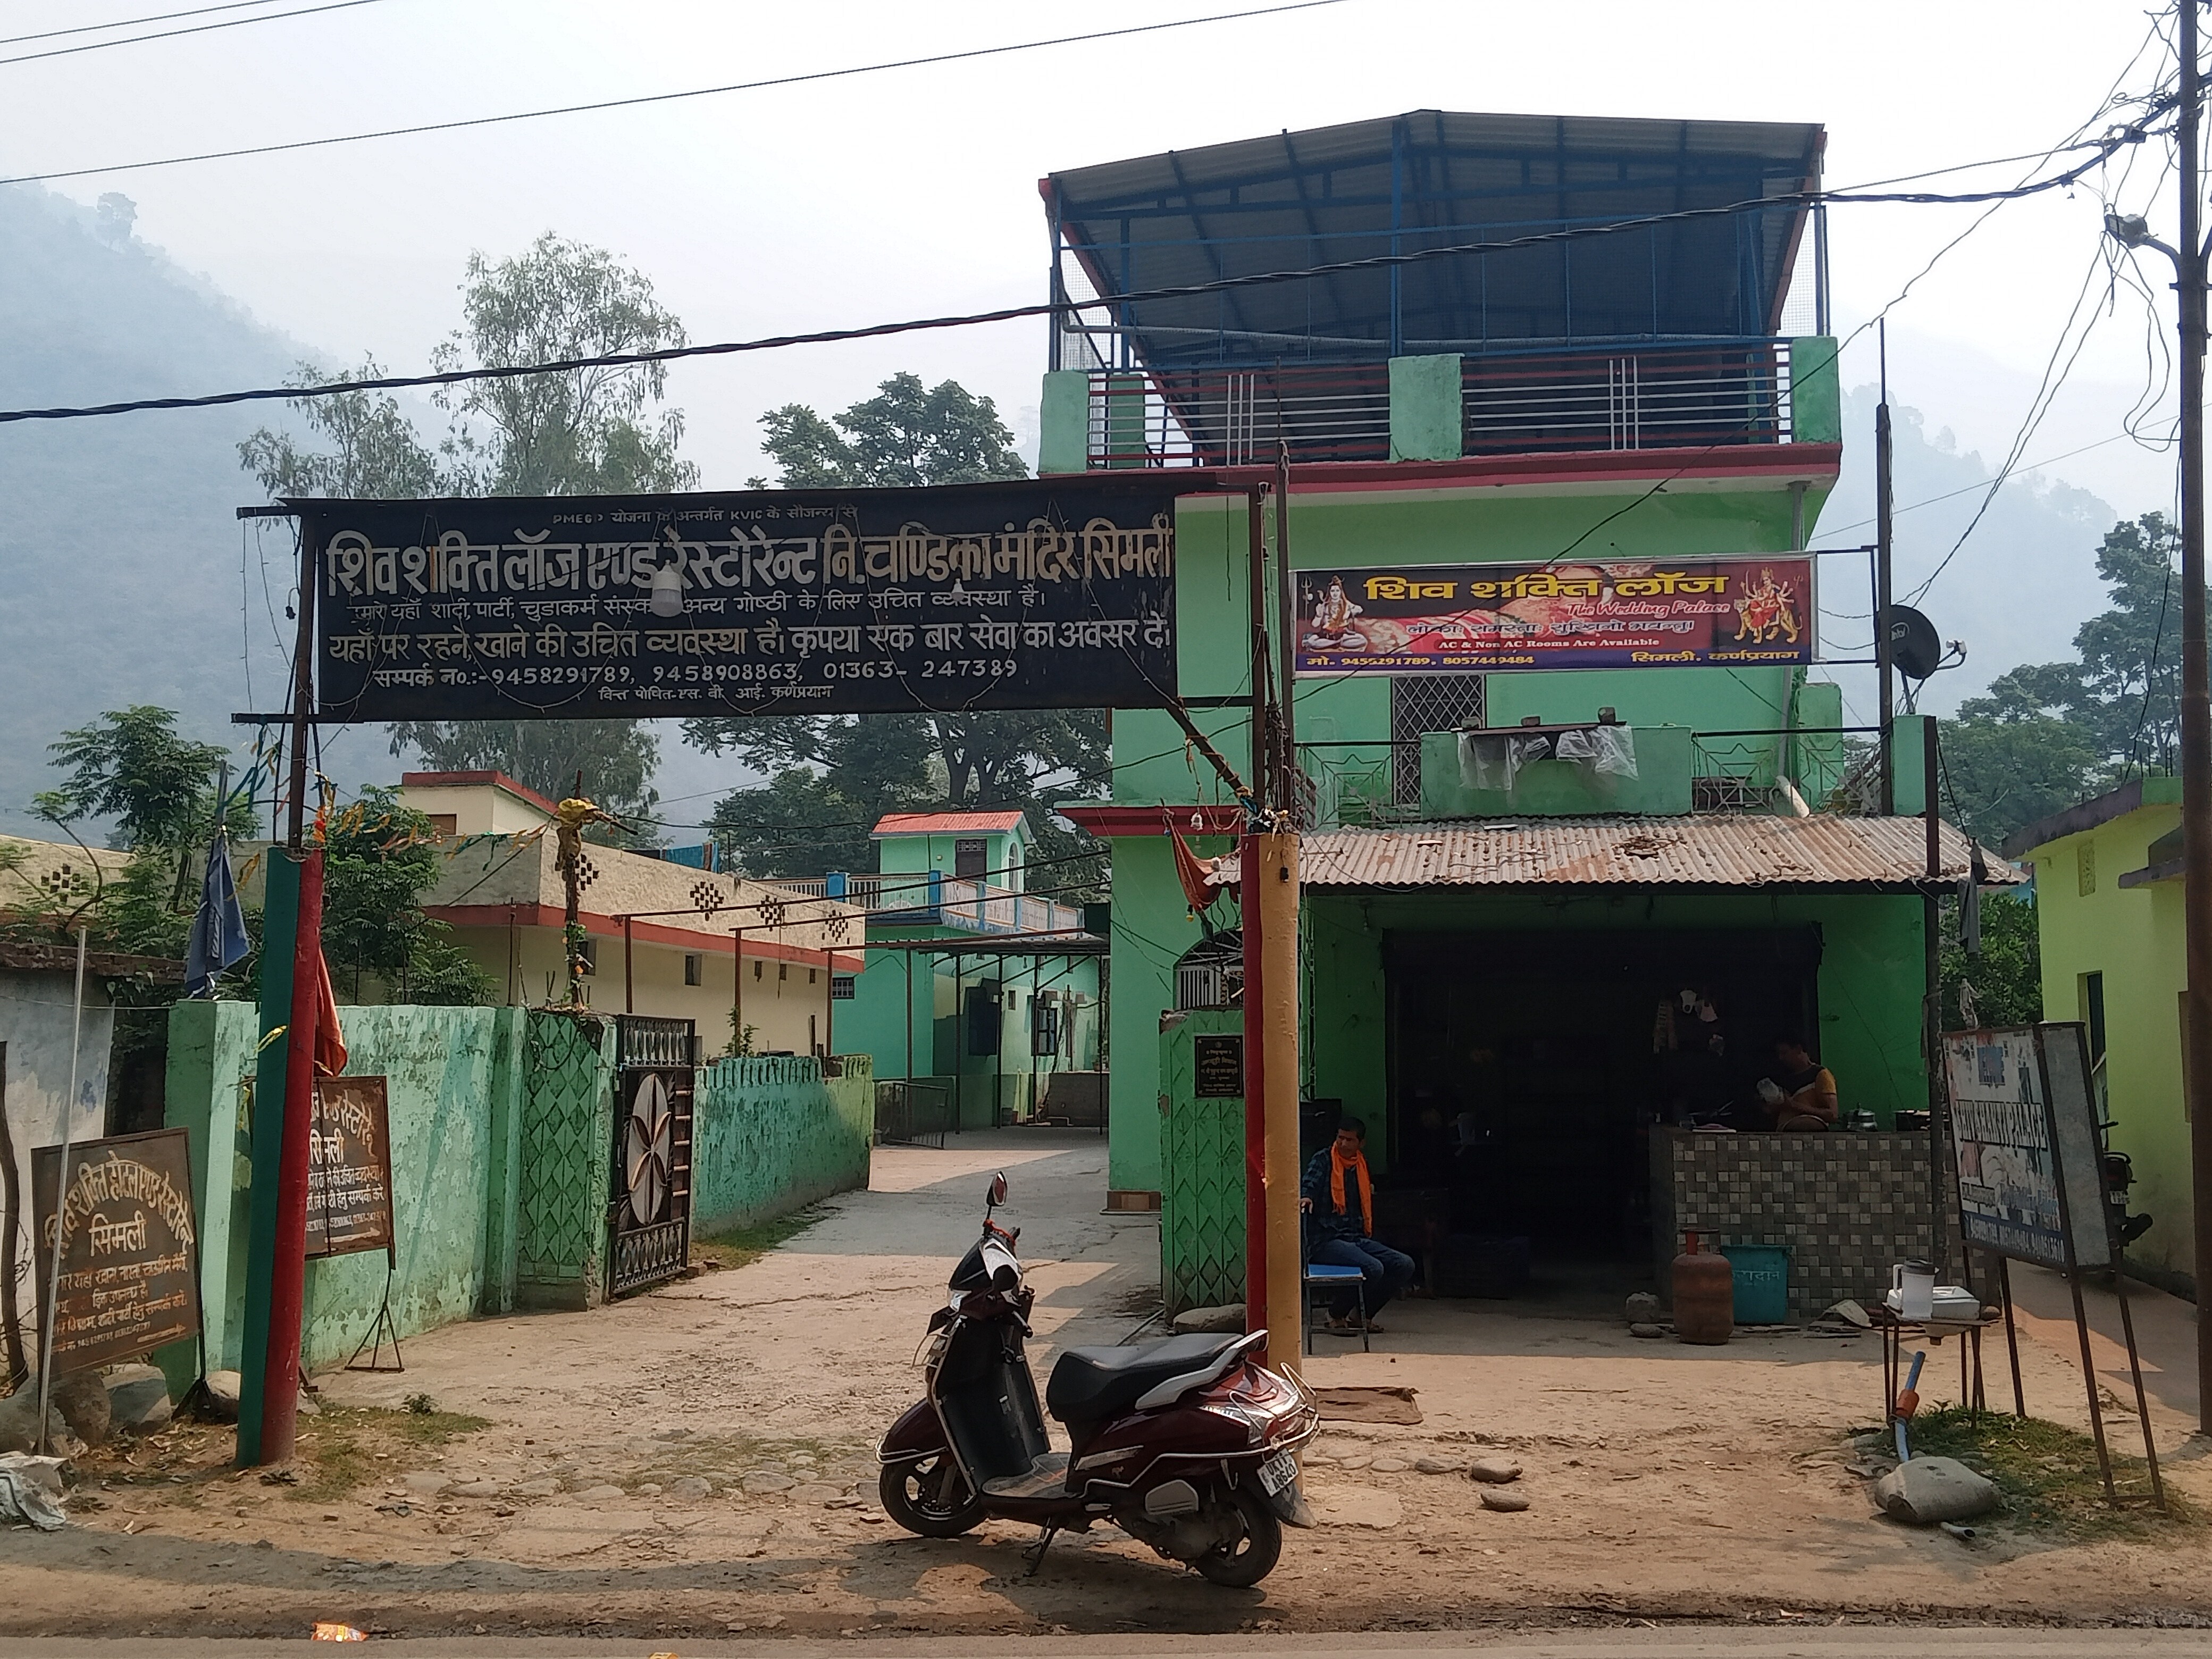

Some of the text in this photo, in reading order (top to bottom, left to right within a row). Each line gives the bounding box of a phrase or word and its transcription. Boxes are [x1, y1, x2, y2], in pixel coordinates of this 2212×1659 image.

[610, 509, 652, 522] योजना
[676, 506, 724, 523] अन्तर्गत
[731, 510, 763, 520] KVIC
[766, 505, 781, 518] के
[325, 530, 399, 596] शिव
[401, 530, 499, 594] शक्ति
[502, 528, 582, 592] लॉज
[585, 542, 660, 590] एण्ड
[820, 524, 865, 584] नि.
[857, 521, 992, 583] चण्डिका
[994, 517, 1079, 583] मंदिर
[1078, 513, 1173, 580] सिमली
[1363, 572, 1730, 600] शिव शक्ति लॉज
[473, 597, 515, 619] पार्टी,
[682, 597, 727, 615] अन्य
[736, 591, 792, 613] गोष्ठी
[798, 589, 819, 611] के
[825, 591, 862, 610] लिए
[868, 586, 925, 609] उचित
[931, 589, 1011, 607] व्यवस्था
[1568, 600, 1730, 618] The Wedding Palace
[330, 627, 375, 663] यहाँ
[381, 634, 410, 659] पर
[475, 624, 530, 658] खाने
[535, 623, 568, 657] की
[571, 622, 639, 657] उचित
[644, 628, 748, 656] व्यवस्था
[787, 626, 861, 658] कृपया
[866, 624, 915, 652] एक
[920, 623, 964, 650] बार
[968, 614, 1019, 649] सेवा
[1023, 622, 1055, 647] का
[1058, 619, 1139, 648] अवसर
[1708, 650, 1800, 661] कर्णप्रयाग
[372, 663, 434, 687] सम्पर्क
[88, 1210, 147, 1257] सिमली
